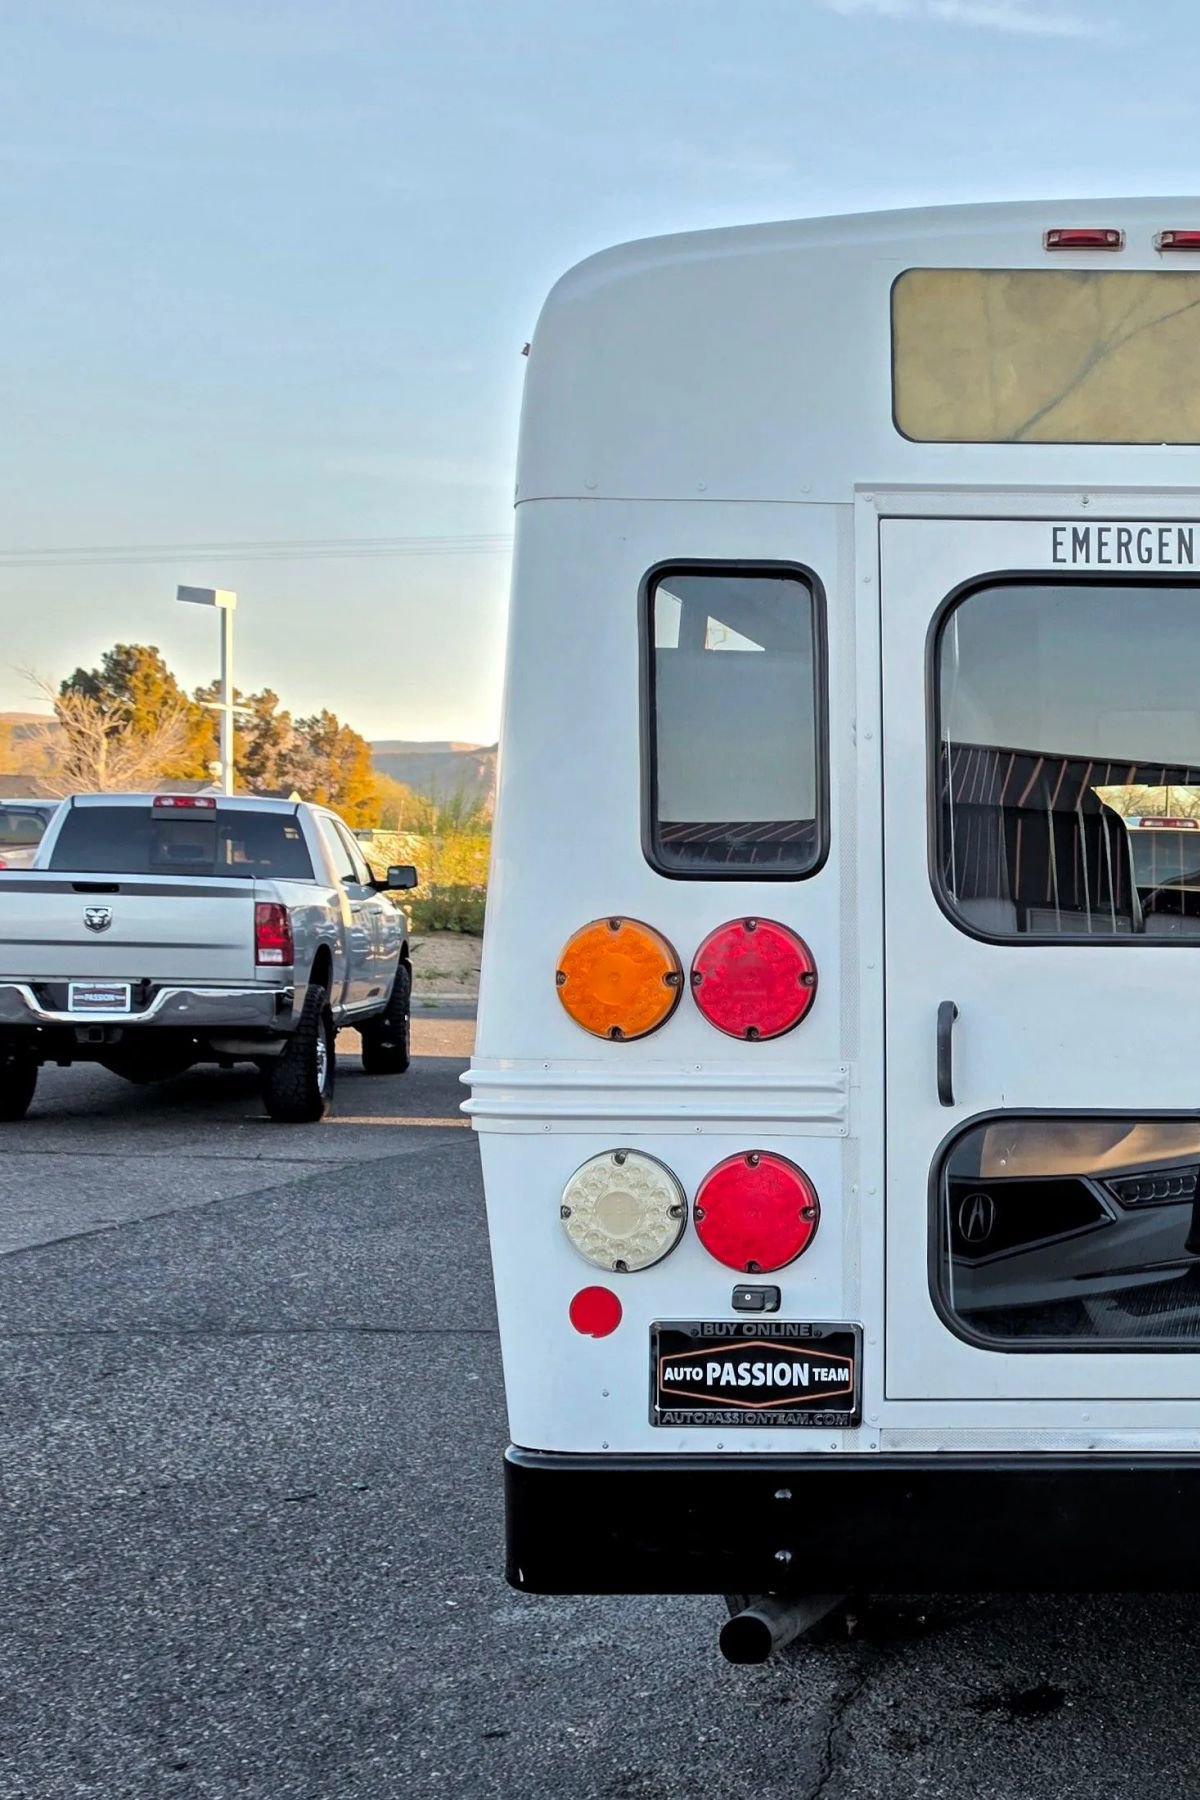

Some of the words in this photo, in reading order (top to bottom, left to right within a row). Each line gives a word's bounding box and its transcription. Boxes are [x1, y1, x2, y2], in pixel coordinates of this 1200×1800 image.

[703, 1323, 738, 1336] BUY
[743, 1324, 810, 1337] ONLINE
[664, 1367, 703, 1381] AUTO
[706, 1362, 809, 1386] PASSION
[812, 1367, 849, 1382] TEAM
[662, 1411, 849, 1426] AUTOPASSIONTEAM.COM
